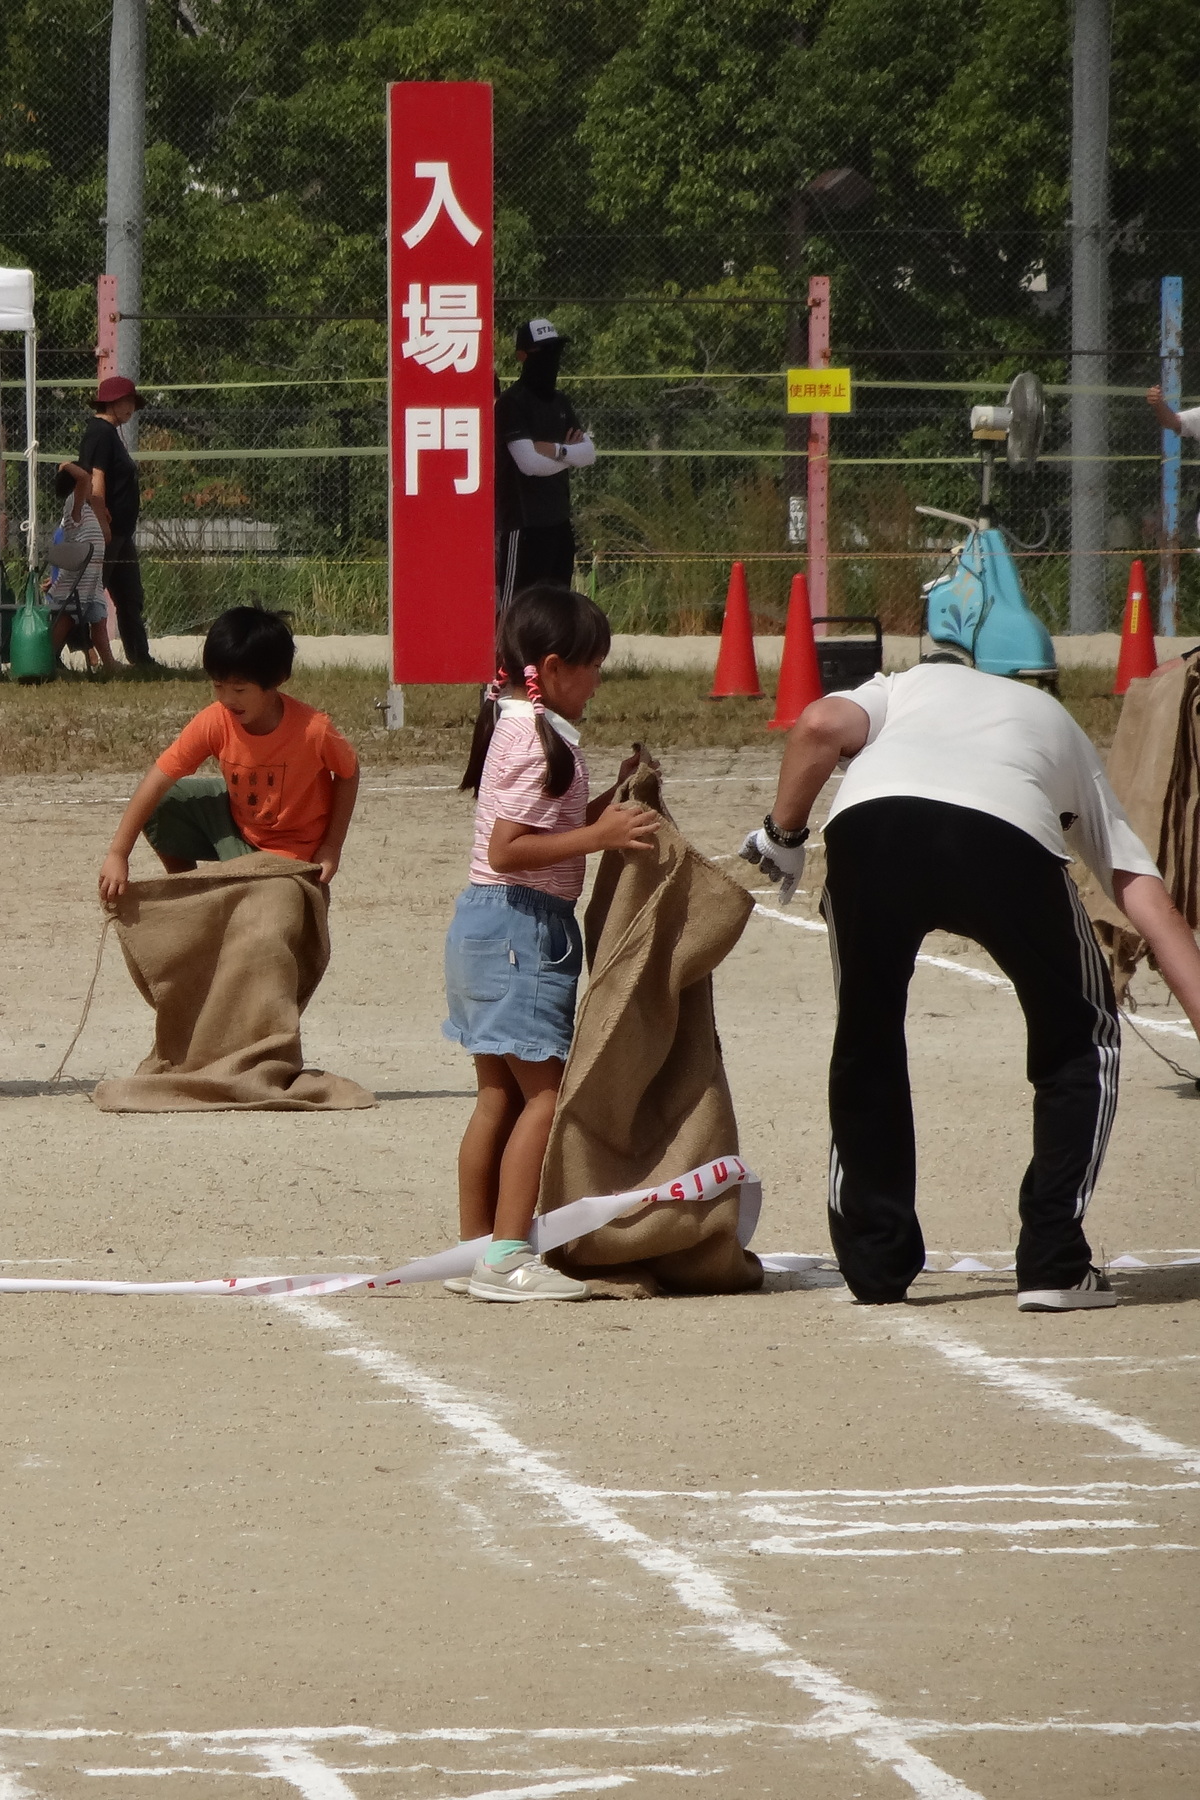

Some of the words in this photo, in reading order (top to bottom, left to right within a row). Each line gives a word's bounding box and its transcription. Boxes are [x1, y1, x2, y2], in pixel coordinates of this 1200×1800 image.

[401, 161, 483, 497] 入場門
[789, 383, 846, 398] 使用禁止
